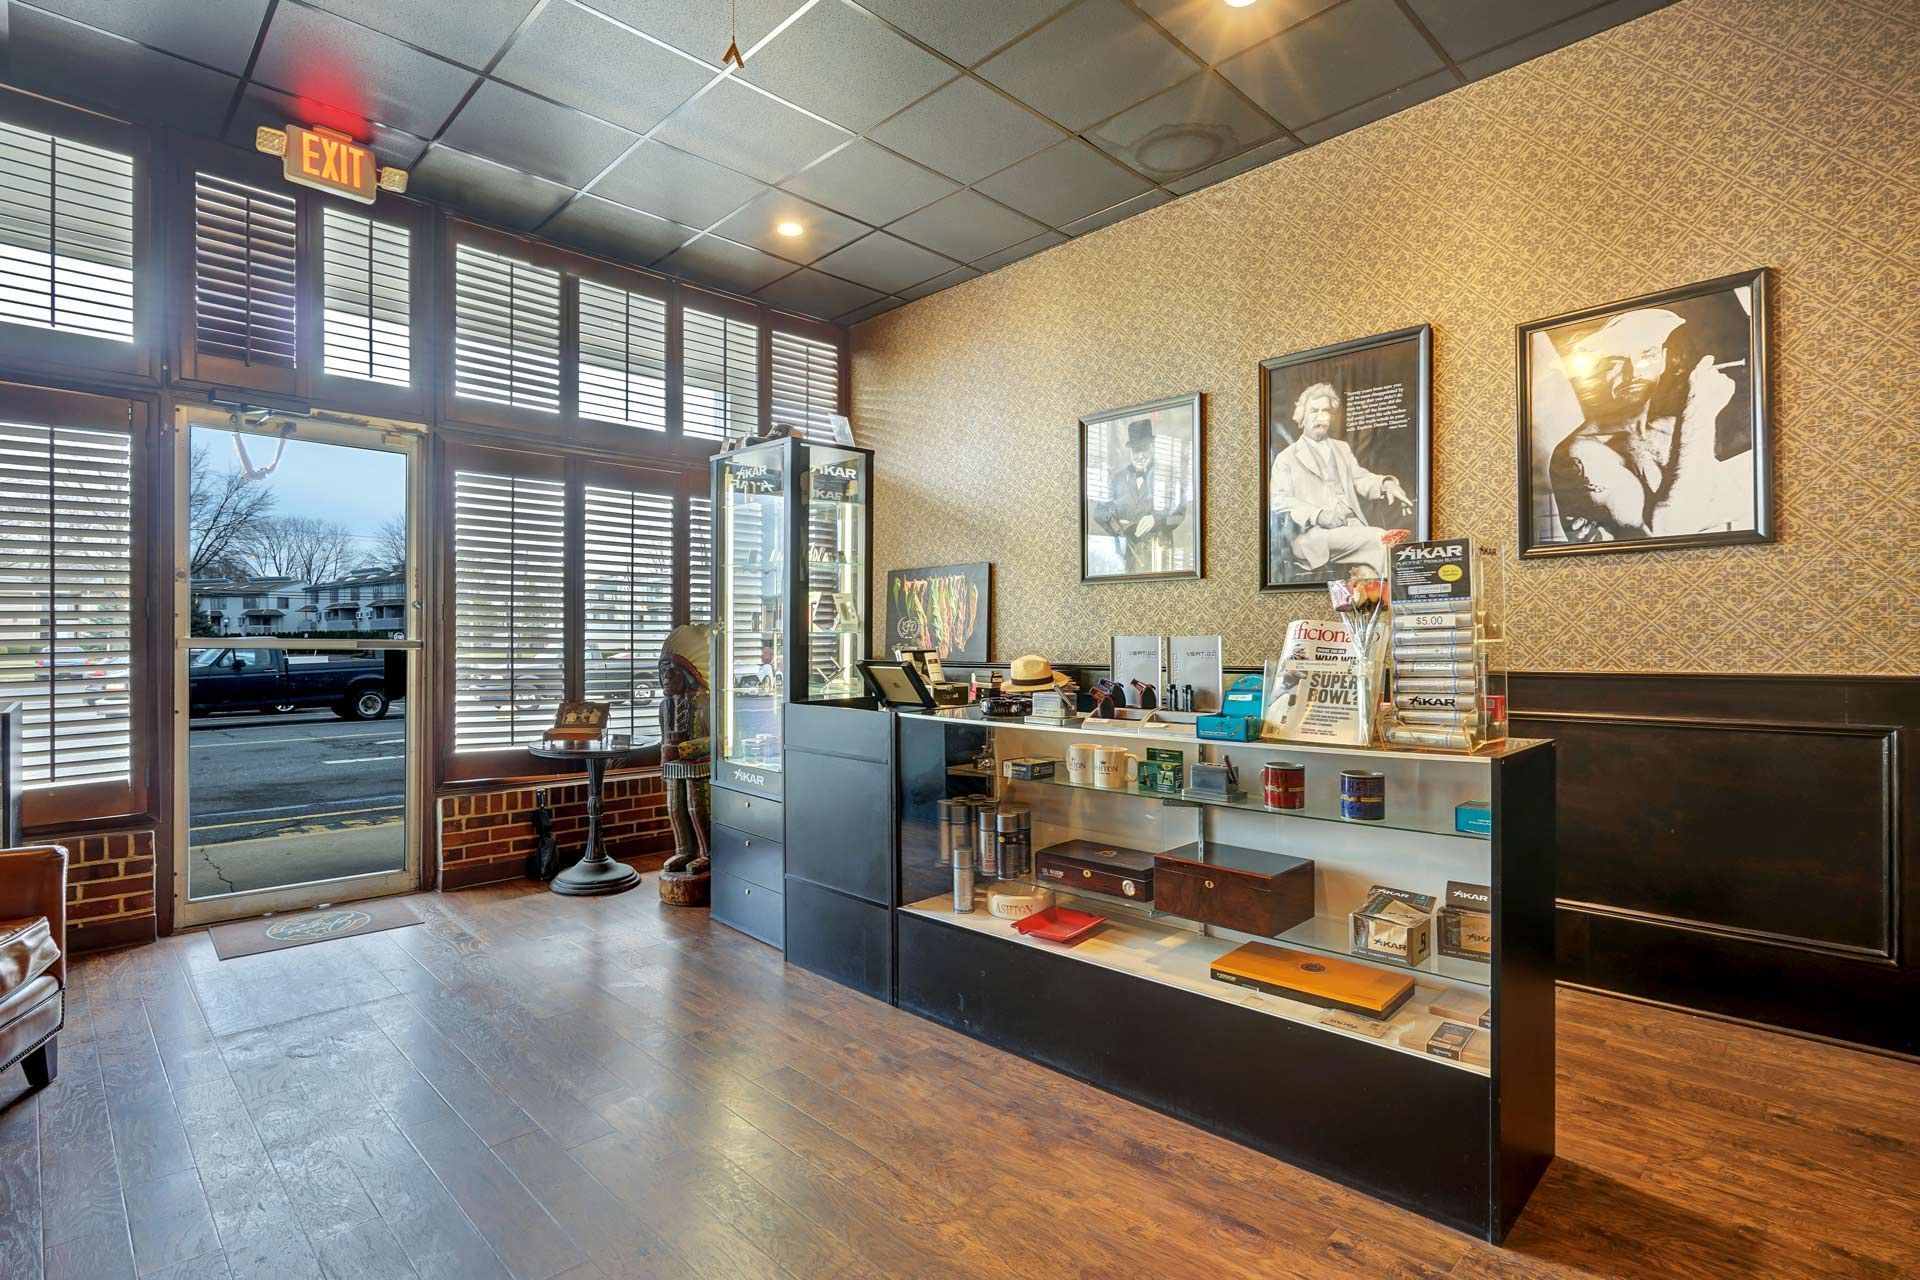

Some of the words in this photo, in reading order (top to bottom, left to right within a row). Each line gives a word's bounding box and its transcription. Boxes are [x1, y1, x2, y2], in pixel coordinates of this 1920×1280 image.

[302, 131, 364, 188] EXIT
[1416, 616, 1443, 625] $5.00
[995, 903, 1033, 916] ASHTON
